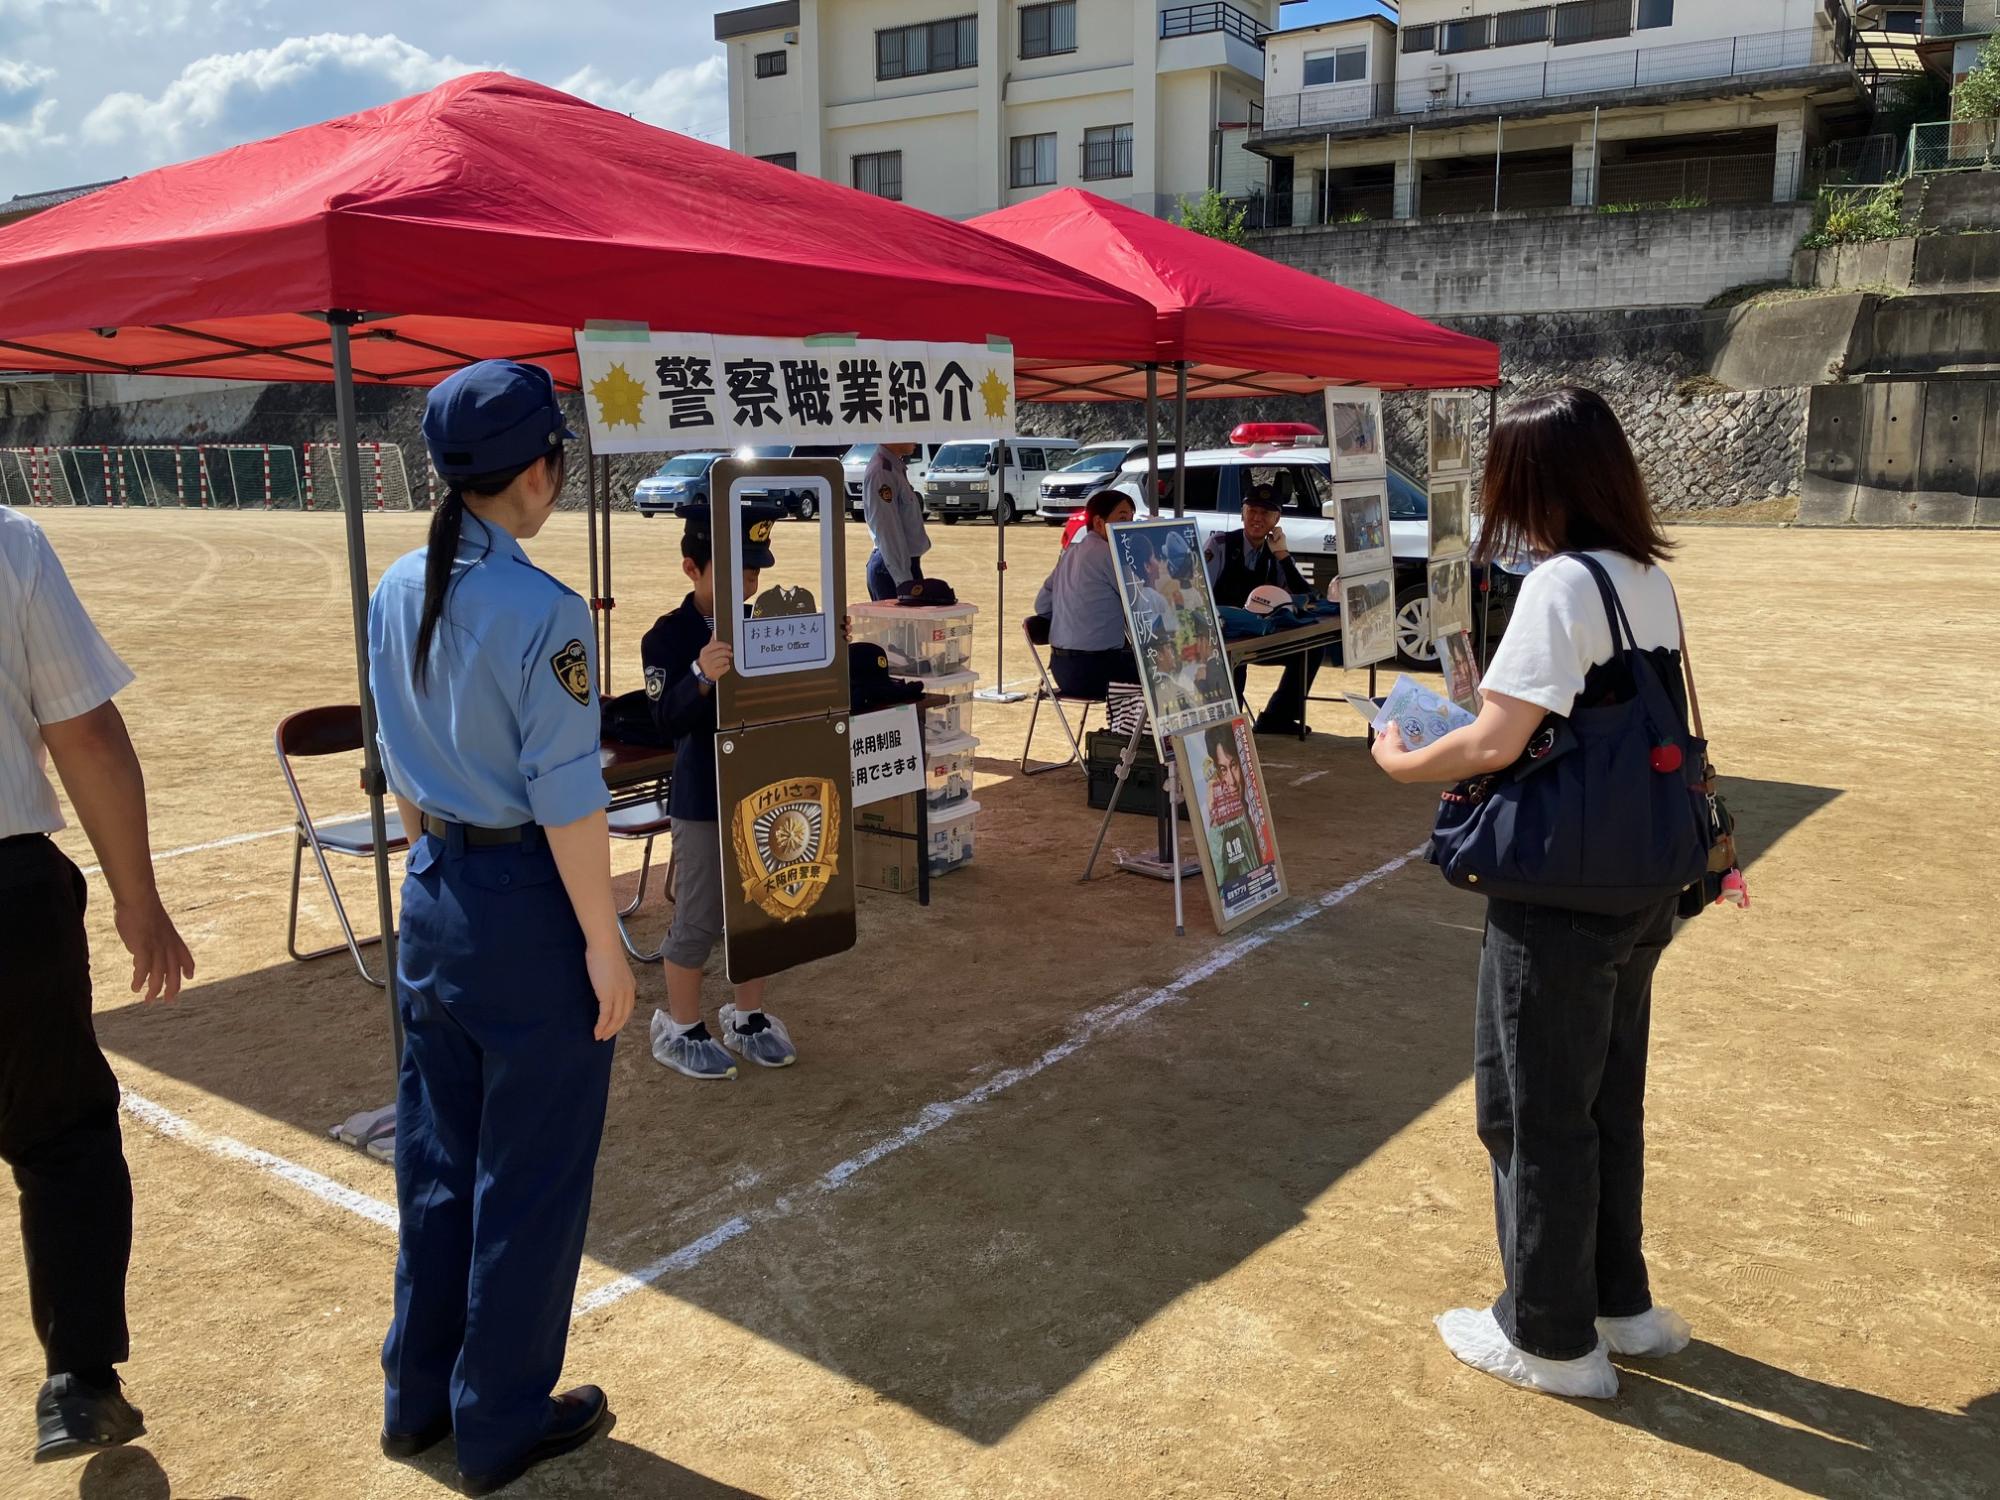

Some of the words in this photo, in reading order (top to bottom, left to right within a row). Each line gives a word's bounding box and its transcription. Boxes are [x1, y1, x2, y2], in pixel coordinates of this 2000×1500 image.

[655, 356, 974, 429] 警察職業紹介
[751, 621, 819, 640] おまわりさん
[760, 644, 784, 654] Police
[787, 641, 810, 650] Officer
[850, 730, 902, 758] 供用制服
[851, 755, 917, 788] 用できます
[758, 784, 818, 809] けいさつ
[764, 866, 821, 893] 大阪府警察
